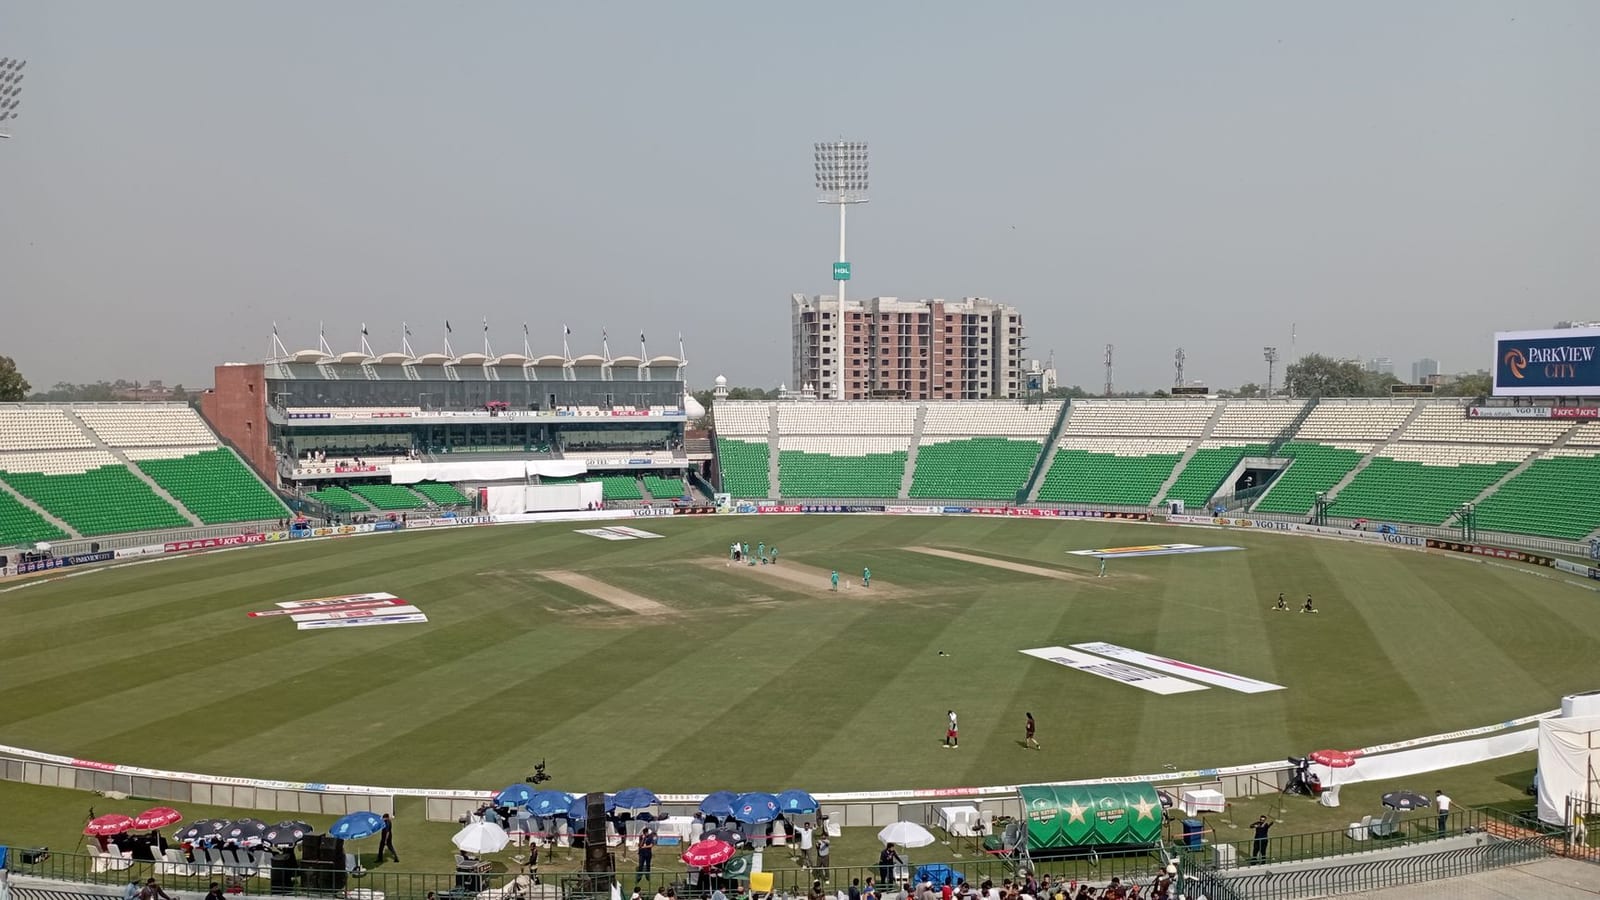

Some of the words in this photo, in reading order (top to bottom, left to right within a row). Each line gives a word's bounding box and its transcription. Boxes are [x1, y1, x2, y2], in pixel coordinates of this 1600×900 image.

[1528, 346, 1595, 362] PARKVIEW
[1544, 364, 1576, 378] CITY
[1256, 520, 1273, 529] VGO
[1276, 522, 1291, 530] TEL
[224, 537, 241, 545] KFC
[246, 535, 262, 543] KFC
[1382, 533, 1402, 544] VGO
[1405, 536, 1421, 545] TEL
